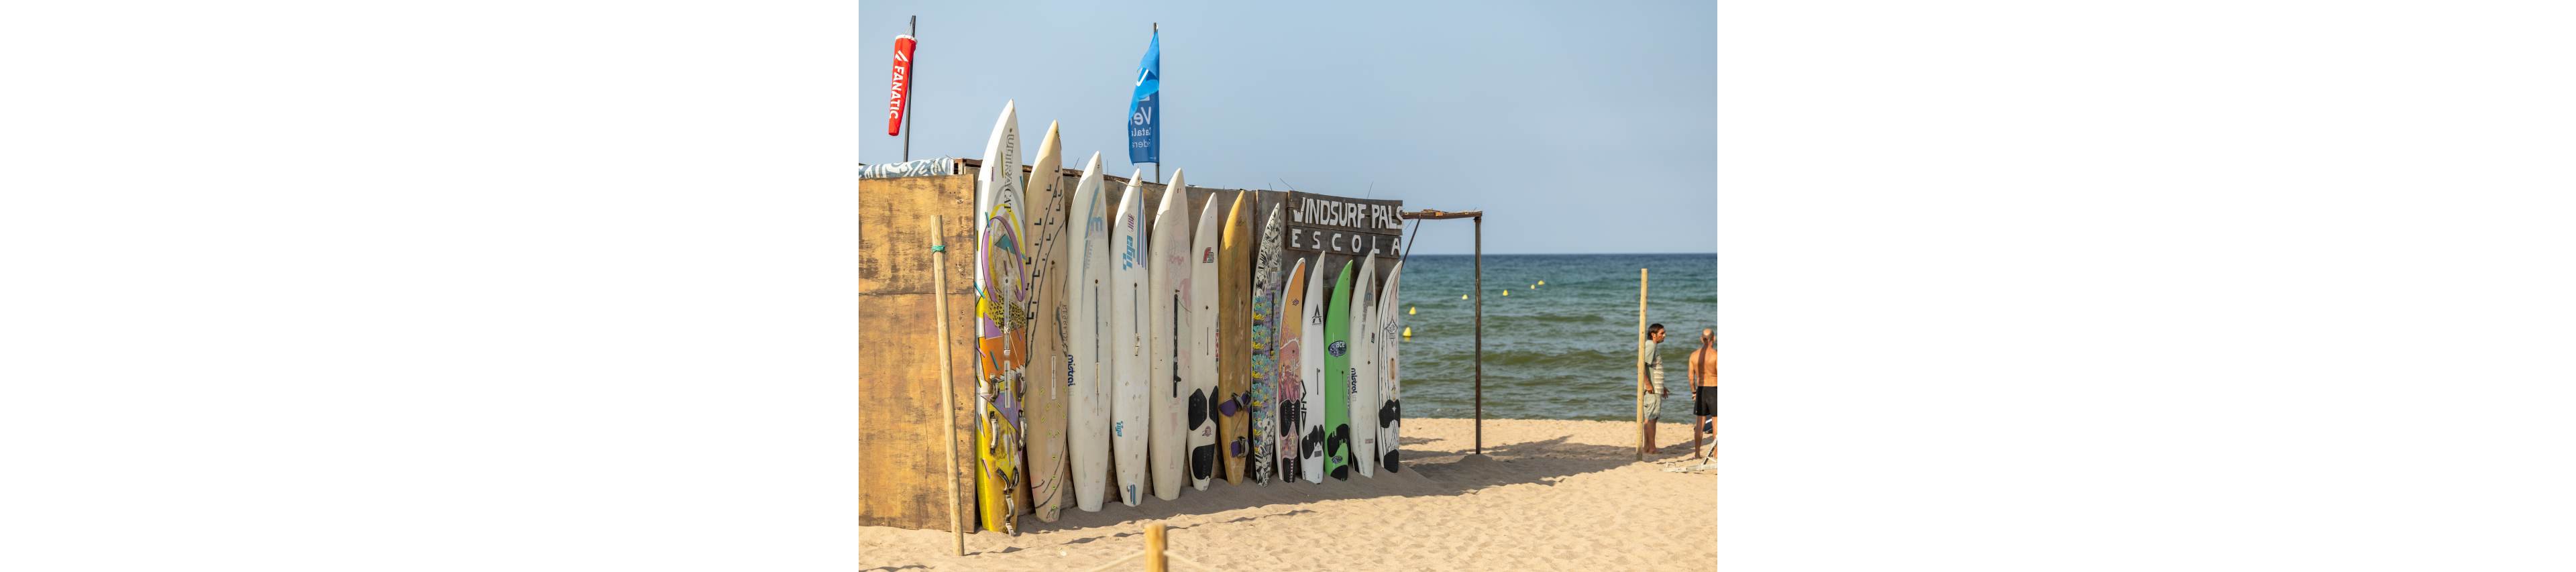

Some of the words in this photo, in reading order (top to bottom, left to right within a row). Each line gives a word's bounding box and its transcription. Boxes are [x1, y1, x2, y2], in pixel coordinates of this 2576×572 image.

[889, 66, 905, 119] FANATIC
[1293, 196, 1366, 229] WINDSURF
[1371, 204, 1403, 229] PALS
[1291, 228, 1401, 255] ESCOLA
[1067, 354, 1076, 387] mistral
